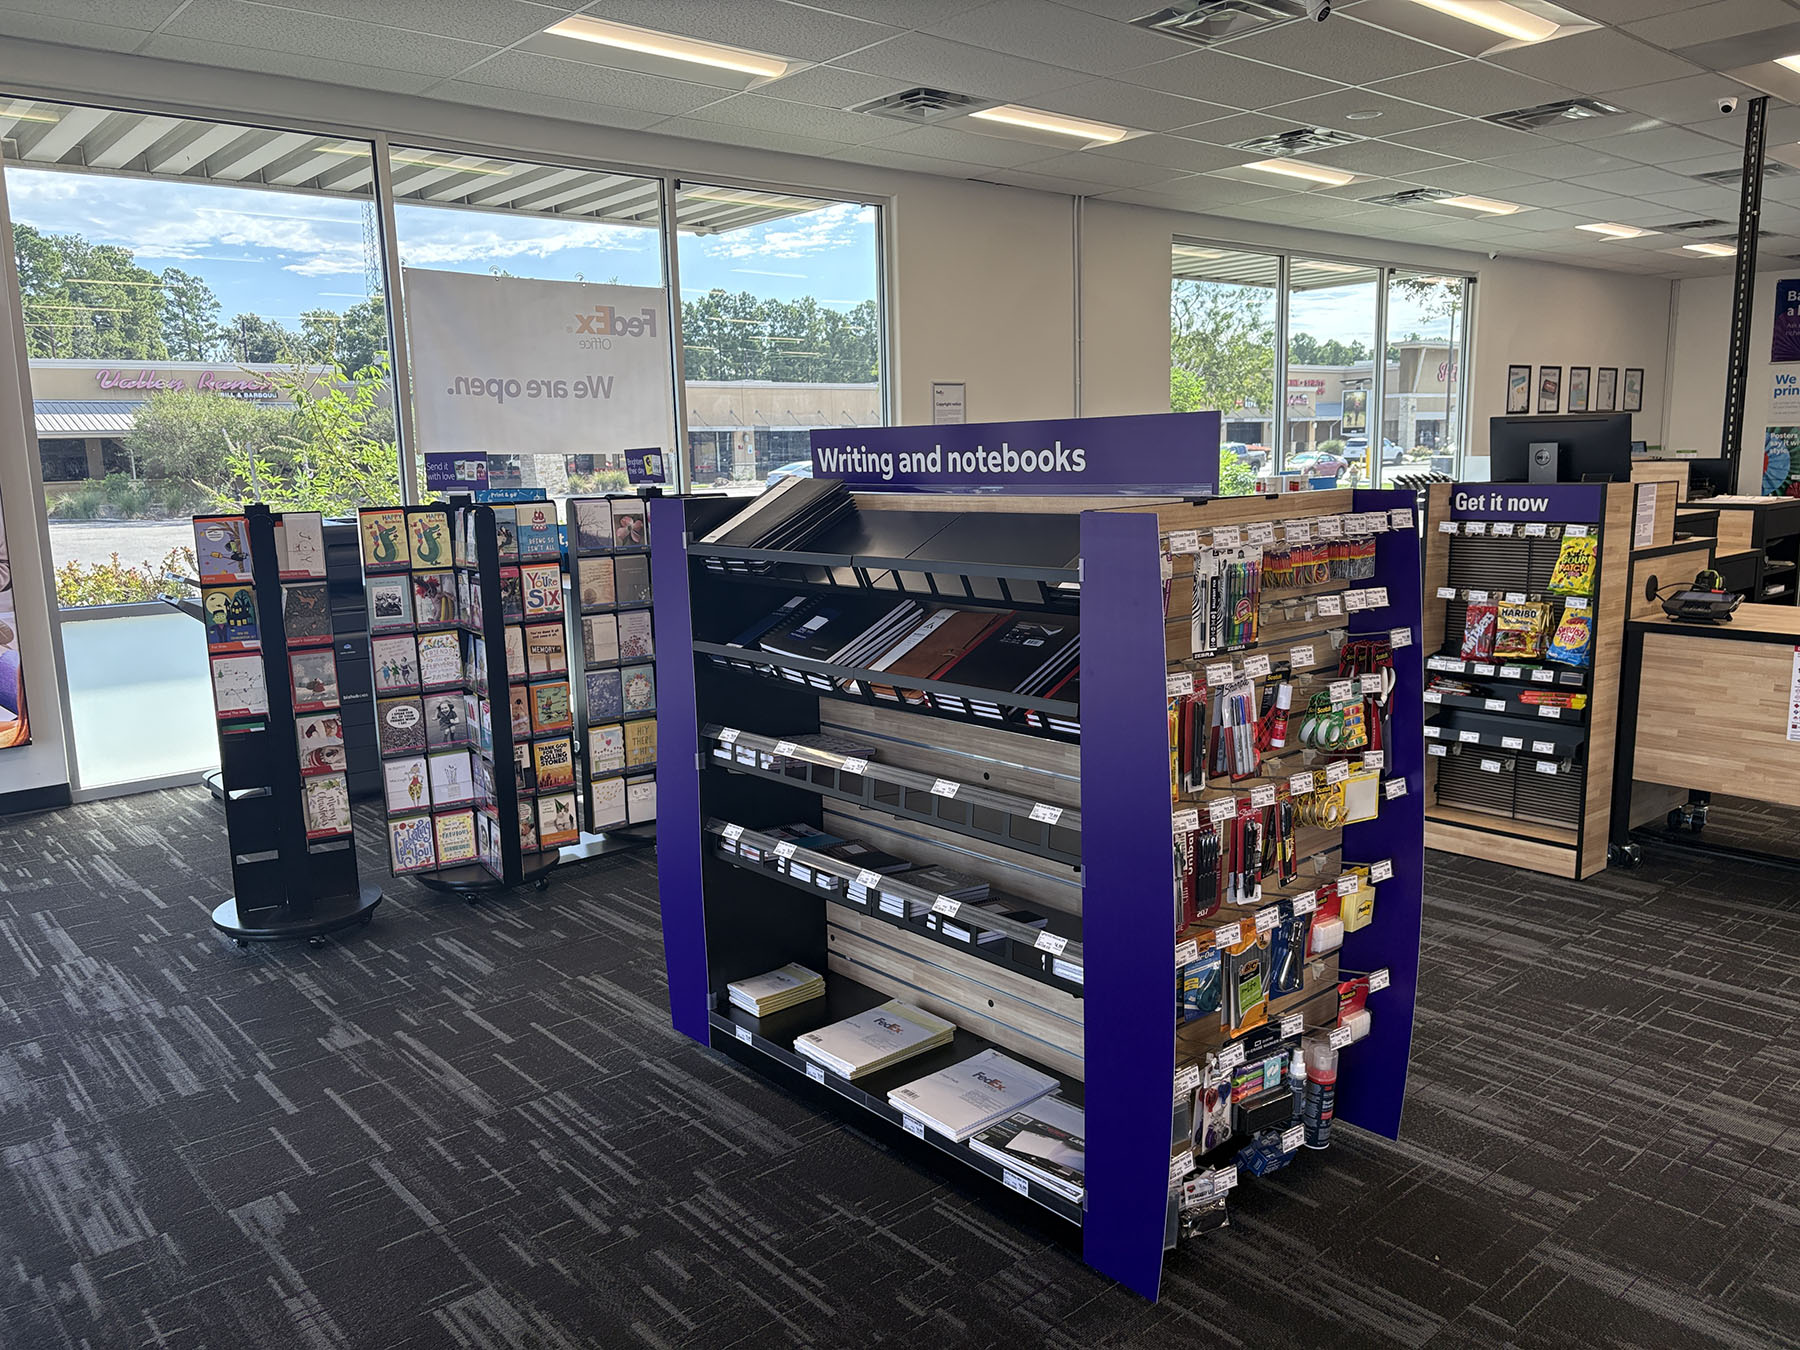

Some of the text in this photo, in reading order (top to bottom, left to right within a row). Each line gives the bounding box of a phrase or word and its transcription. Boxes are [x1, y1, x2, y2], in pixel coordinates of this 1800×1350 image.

[96, 369, 185, 392] Valley
[1776, 374, 1796, 384] We
[817, 440, 1086, 481] Writing and notebooks
[426, 462, 448, 471] Send it
[428, 472, 455, 480] with love
[1455, 492, 1548, 512] Get it now
[546, 544, 554, 552] ALL
[1562, 554, 1588, 564] SOUR
[1558, 564, 1589, 572] PATCH
[1501, 608, 1537, 618] HARIBO
[1556, 625, 1586, 640] Swedish
[1560, 634, 1576, 646] Fish
[1376, 652, 1389, 660] Scotch
[1317, 706, 1332, 714] Scotch
[637, 726, 650, 736] HEY
[538, 744, 555, 752] THANK
[640, 746, 648, 755] HI
[540, 752, 568, 762] ROLLING
[541, 758, 568, 767] STONES!
[1316, 786, 1331, 794] Scotch
[1196, 908, 1209, 918] 207
[1358, 904, 1370, 914] Post-it
[1244, 961, 1257, 972] BIC
[1340, 990, 1356, 1000] Scotch
[873, 1017, 904, 1033] FedEx
[972, 1071, 1006, 1091] FedEx
